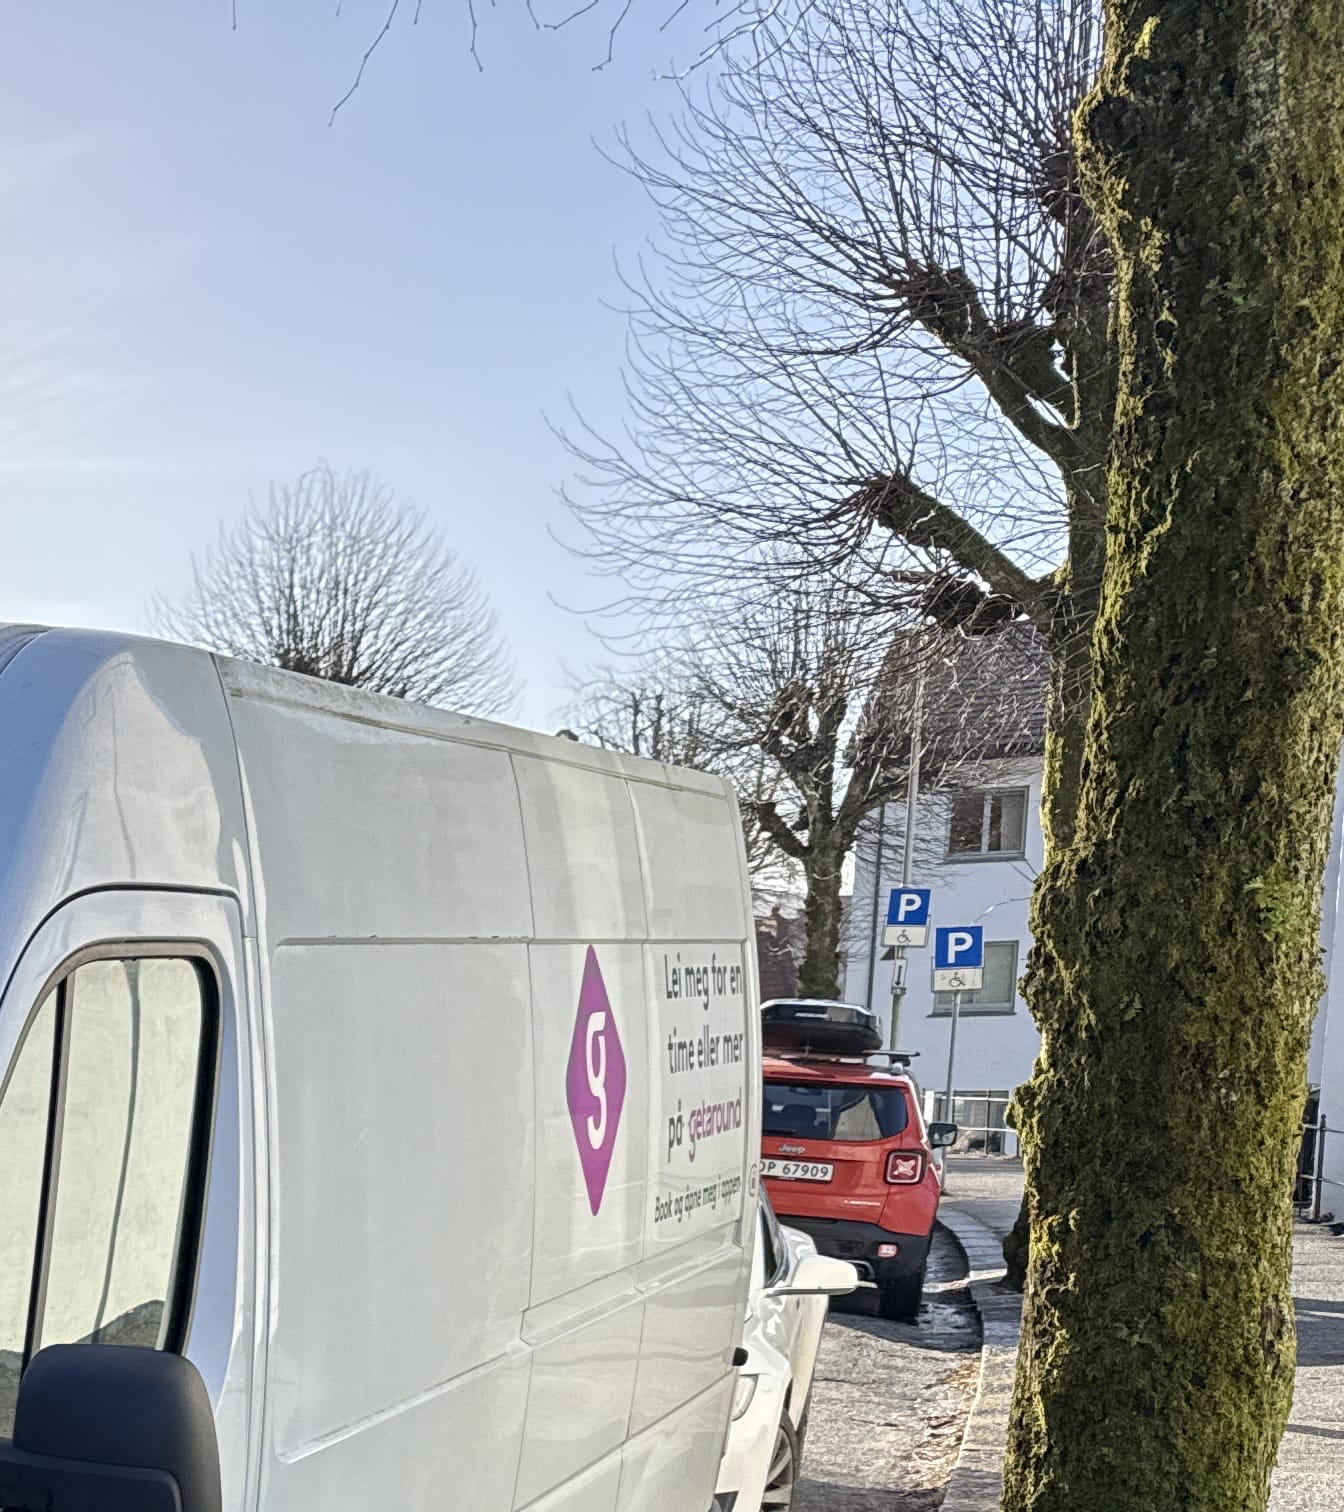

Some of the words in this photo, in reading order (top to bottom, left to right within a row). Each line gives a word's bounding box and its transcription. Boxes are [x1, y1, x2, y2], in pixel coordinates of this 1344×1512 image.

[898, 893, 922, 922] P
[947, 932, 973, 964] P
[664, 951, 682, 999] Lei
[685, 966, 710, 1010] meg
[711, 952, 727, 996] for
[730, 965, 743, 995] en
[668, 1026, 695, 1074] time
[698, 1023, 720, 1069] eller
[723, 1032, 743, 1064] mer
[668, 1098, 683, 1163] på
[688, 1085, 742, 1163] getaround
[782, 1162, 829, 1178] 67909
[654, 1191, 673, 1223] Book
[674, 1195, 684, 1223] og
[703, 1183, 717, 1210] meg
